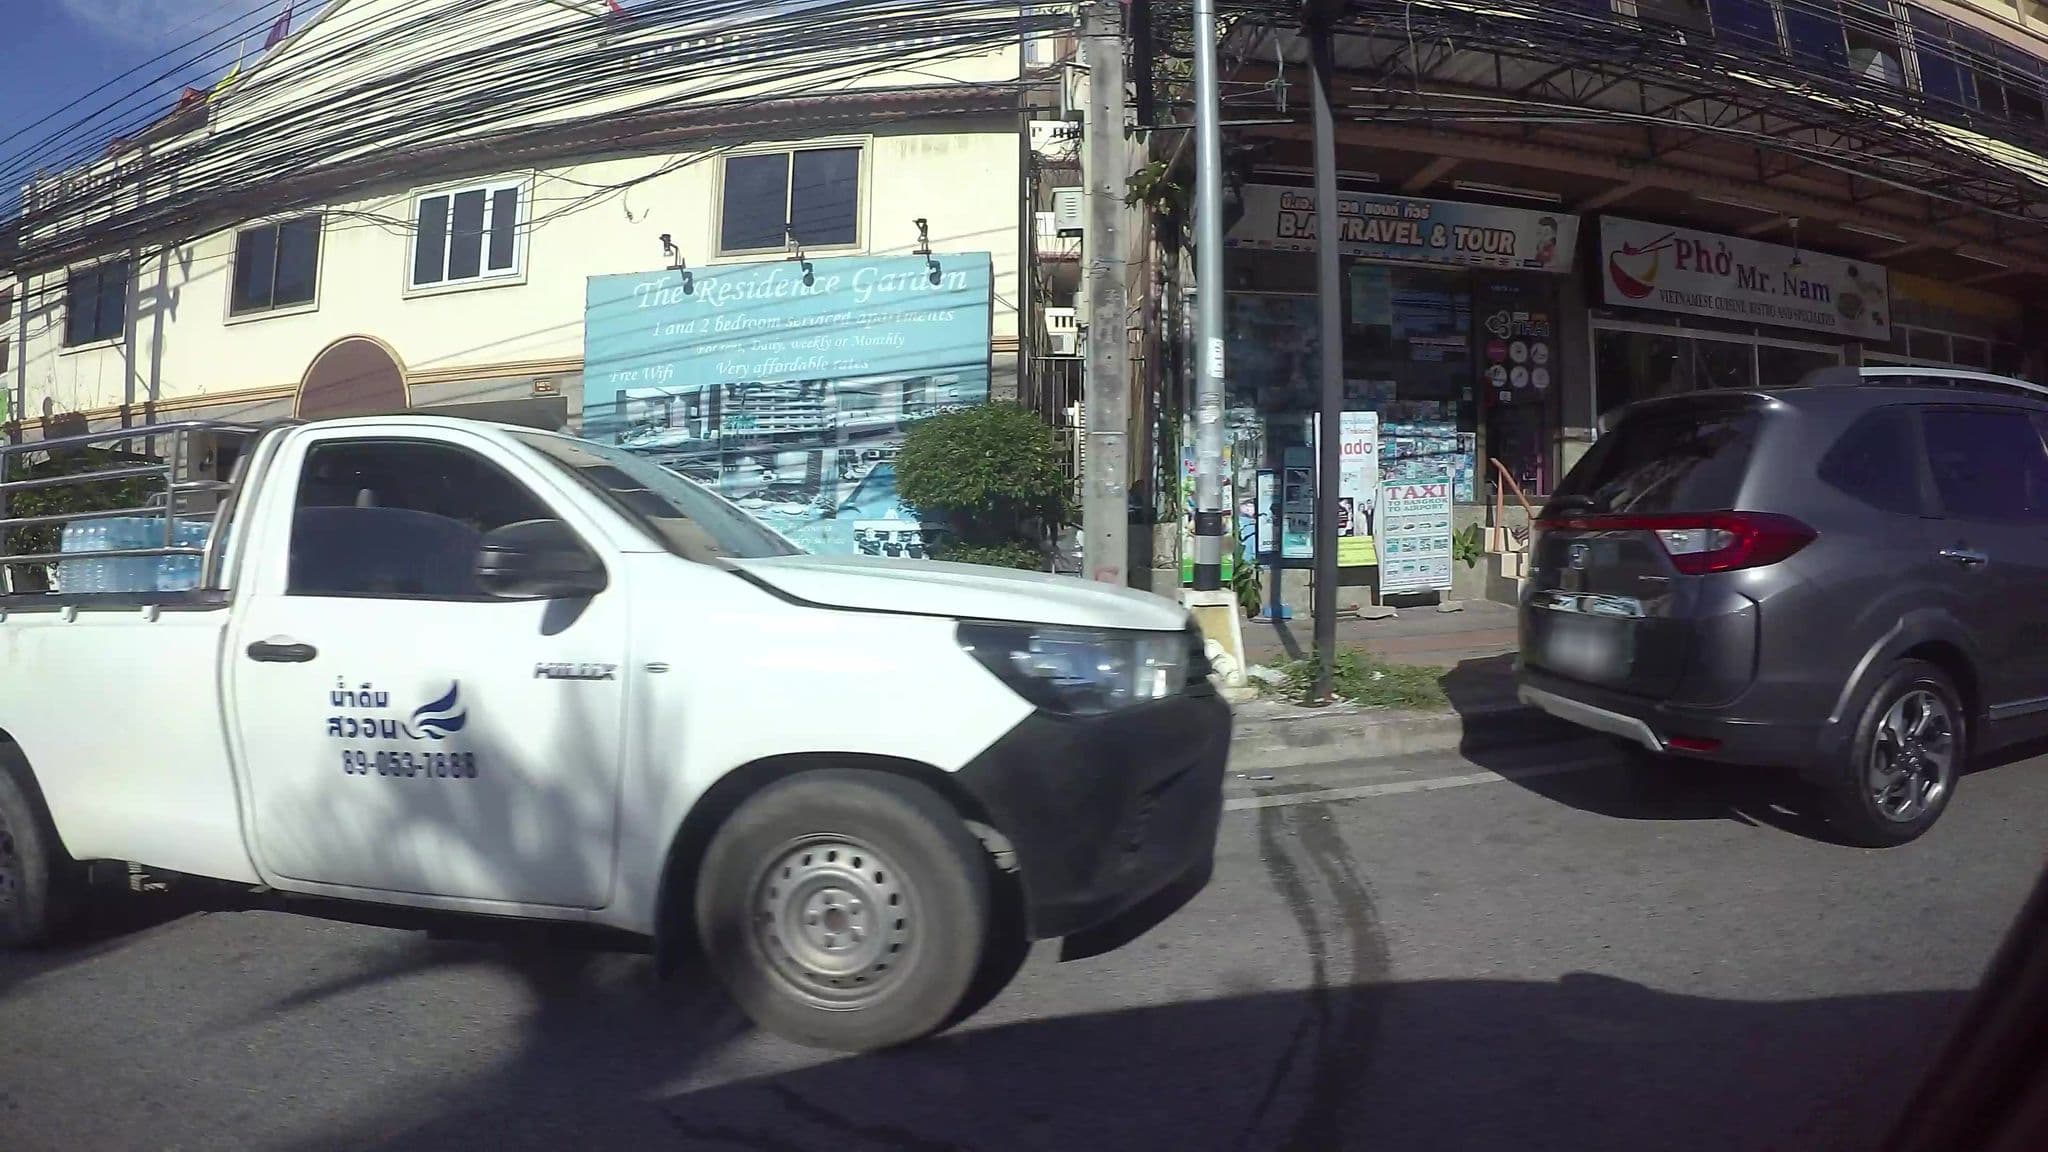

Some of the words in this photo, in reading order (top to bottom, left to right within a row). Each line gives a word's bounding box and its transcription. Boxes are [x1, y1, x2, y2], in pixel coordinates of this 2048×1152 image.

[1338, 215, 1423, 247] TRAVEL
[1430, 223, 1448, 249] &
[1453, 225, 1515, 257] TOUR
[634, 276, 684, 309] The
[691, 267, 841, 307] Residence
[853, 265, 968, 304] Garden
[1737, 264, 1776, 294] Mr.
[1783, 271, 1831, 304] Nam
[665, 319, 694, 336] and
[699, 318, 709, 334] 2
[714, 313, 781, 333] bedroom
[791, 334, 832, 352] weekly
[835, 337, 848, 348] or
[853, 330, 906, 349] Monthly
[608, 369, 638, 383] Free
[642, 363, 675, 385] Wifi
[714, 359, 749, 379] Very
[752, 355, 828, 379] affordable
[1385, 484, 1448, 501] TAXI
[1403, 497, 1449, 506] BANGKOK
[1403, 503, 1443, 512] AIRPORT
